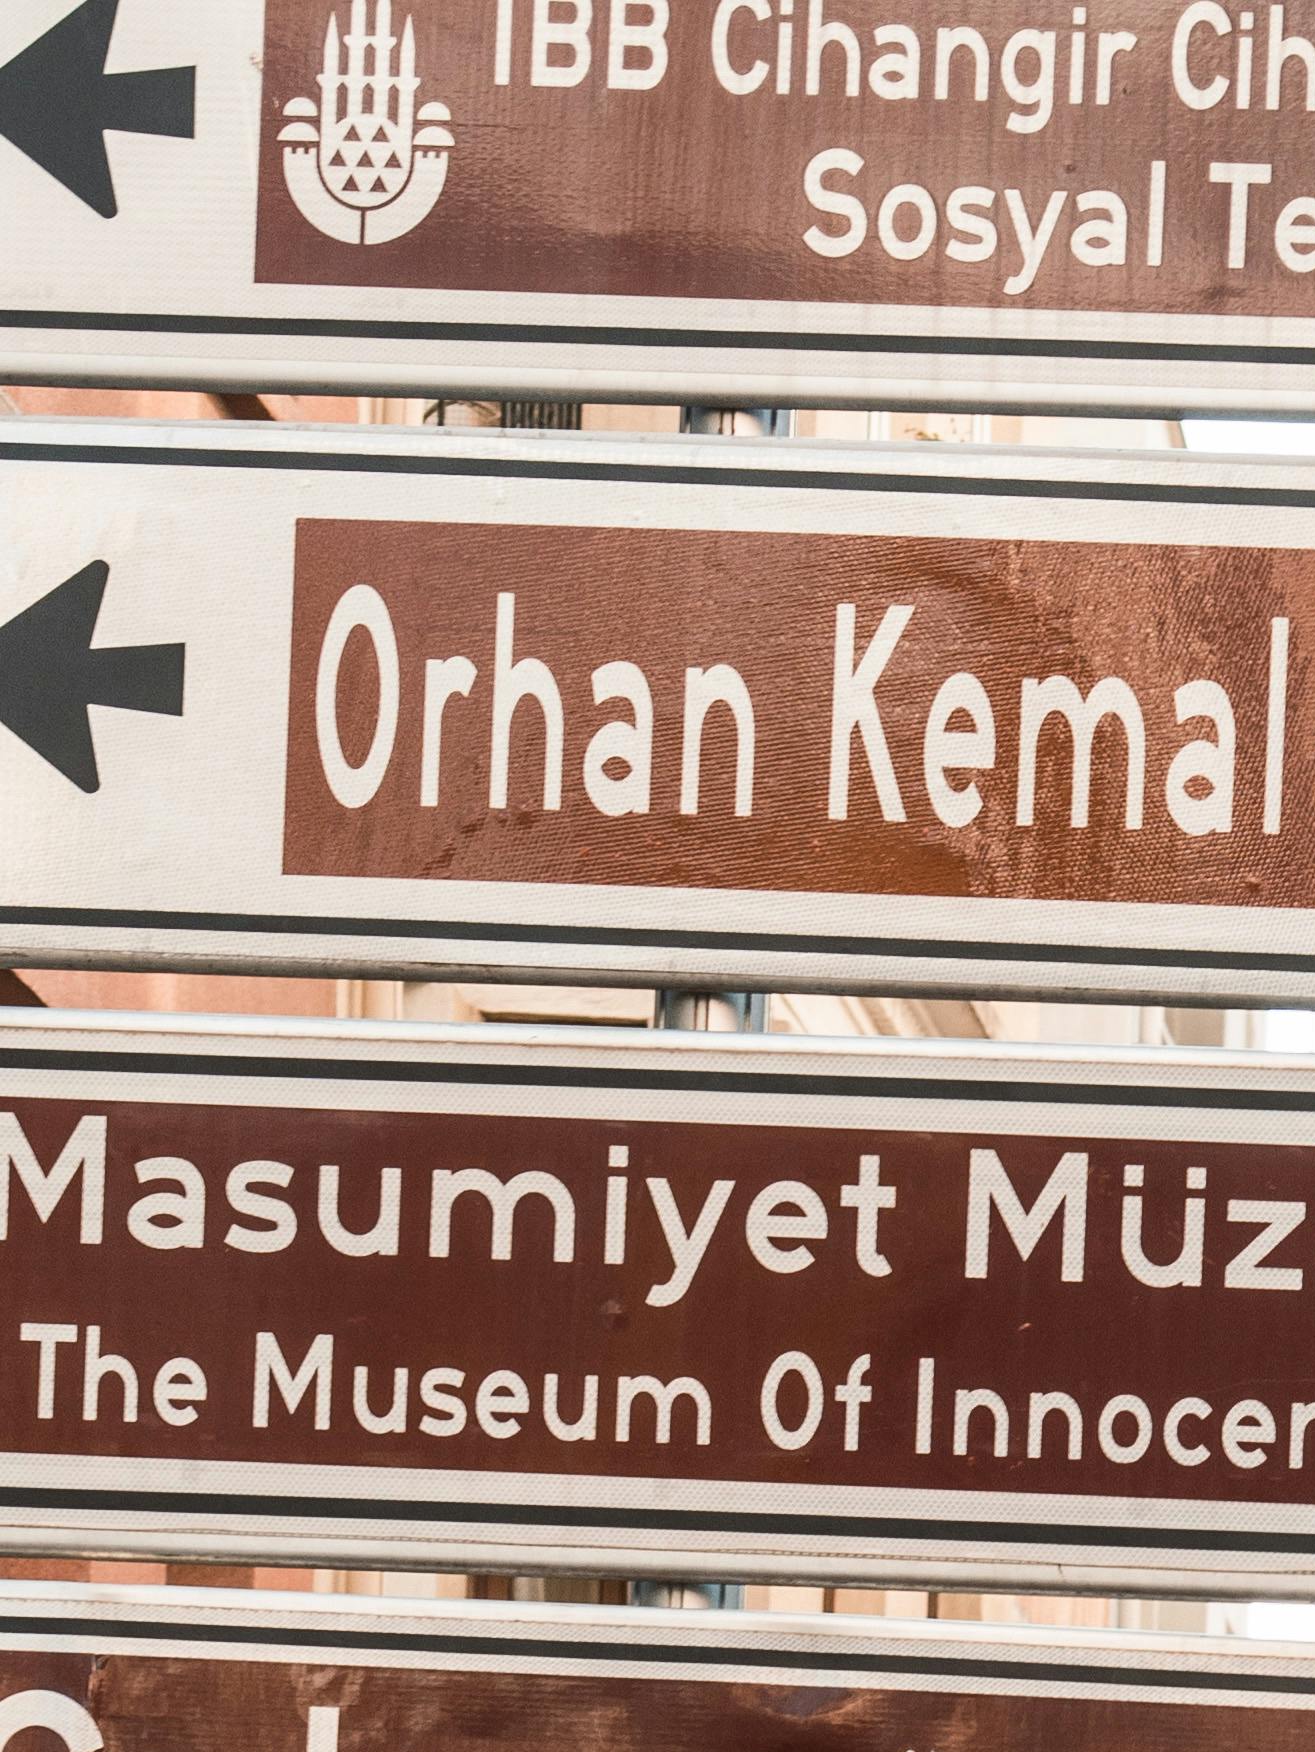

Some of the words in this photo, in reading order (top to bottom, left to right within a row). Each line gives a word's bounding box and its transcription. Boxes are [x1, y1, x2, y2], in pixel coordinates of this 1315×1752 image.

[711, 0, 1138, 134] Cihangir
[802, 147, 1166, 296] Sosyal
[315, 584, 756, 817] Orhan
[828, 603, 1290, 837] Kemal
[0, 1111, 896, 1307] Masumiyet
[20, 1322, 207, 1427] The
[253, 1331, 712, 1445] Museum
[761, 1350, 872, 1452] Of
